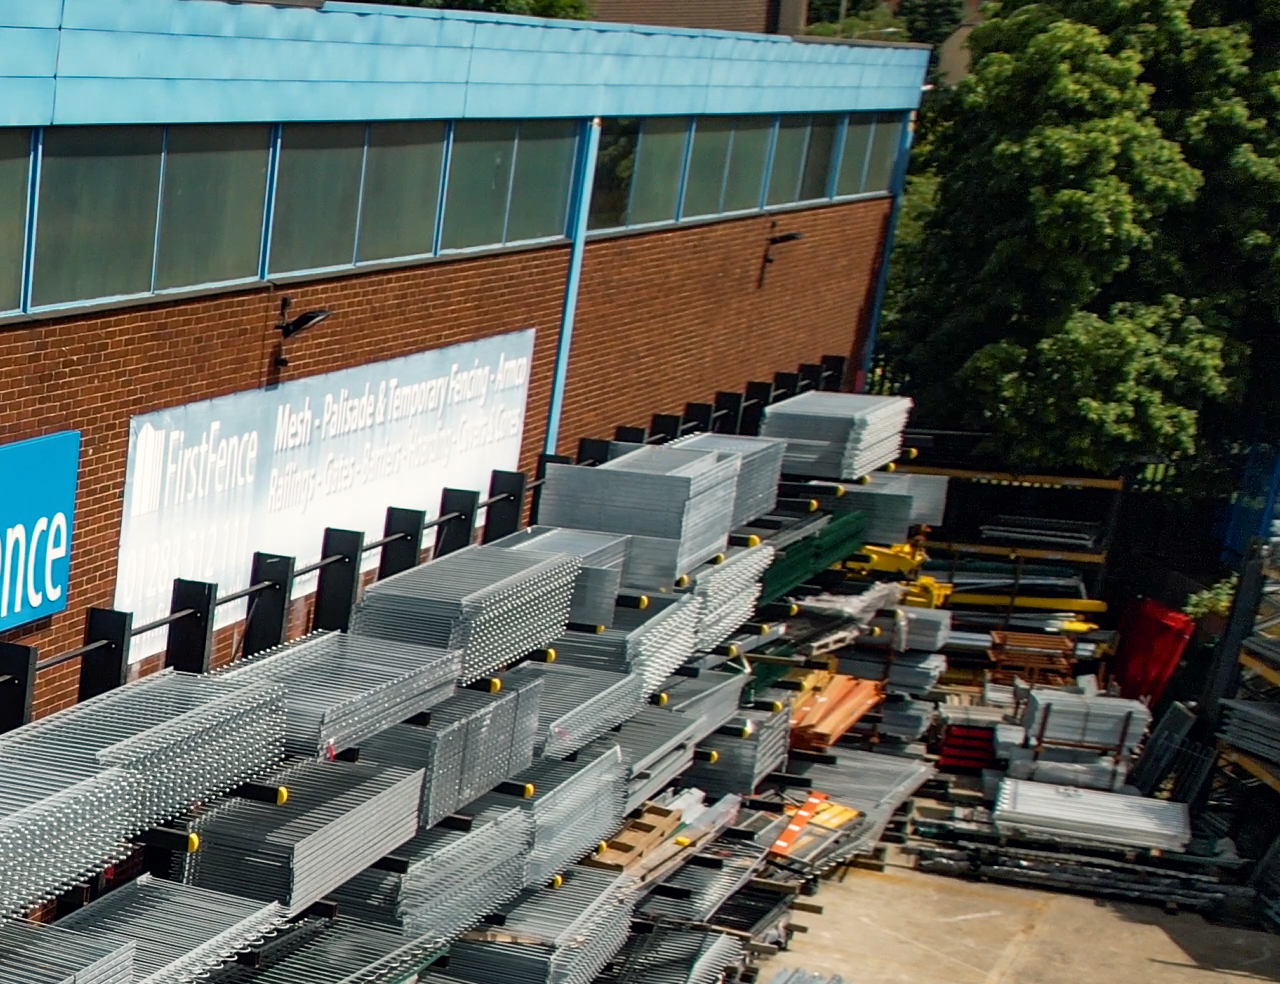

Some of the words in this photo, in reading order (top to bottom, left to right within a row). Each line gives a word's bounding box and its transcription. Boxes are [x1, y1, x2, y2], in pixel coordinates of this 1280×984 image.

[274, 397, 312, 452] Mesh
[321, 383, 375, 441] Palisade
[376, 381, 387, 424] &
[388, 376, 450, 424] Temporary
[447, 363, 491, 408] Fencing
[494, 352, 527, 393] Armco
[164, 421, 258, 508] FirstFence
[269, 461, 316, 514] Railings
[325, 452, 355, 496] Gates
[362, 438, 403, 485] Barriers
[410, 419, 453, 468] Hoarding
